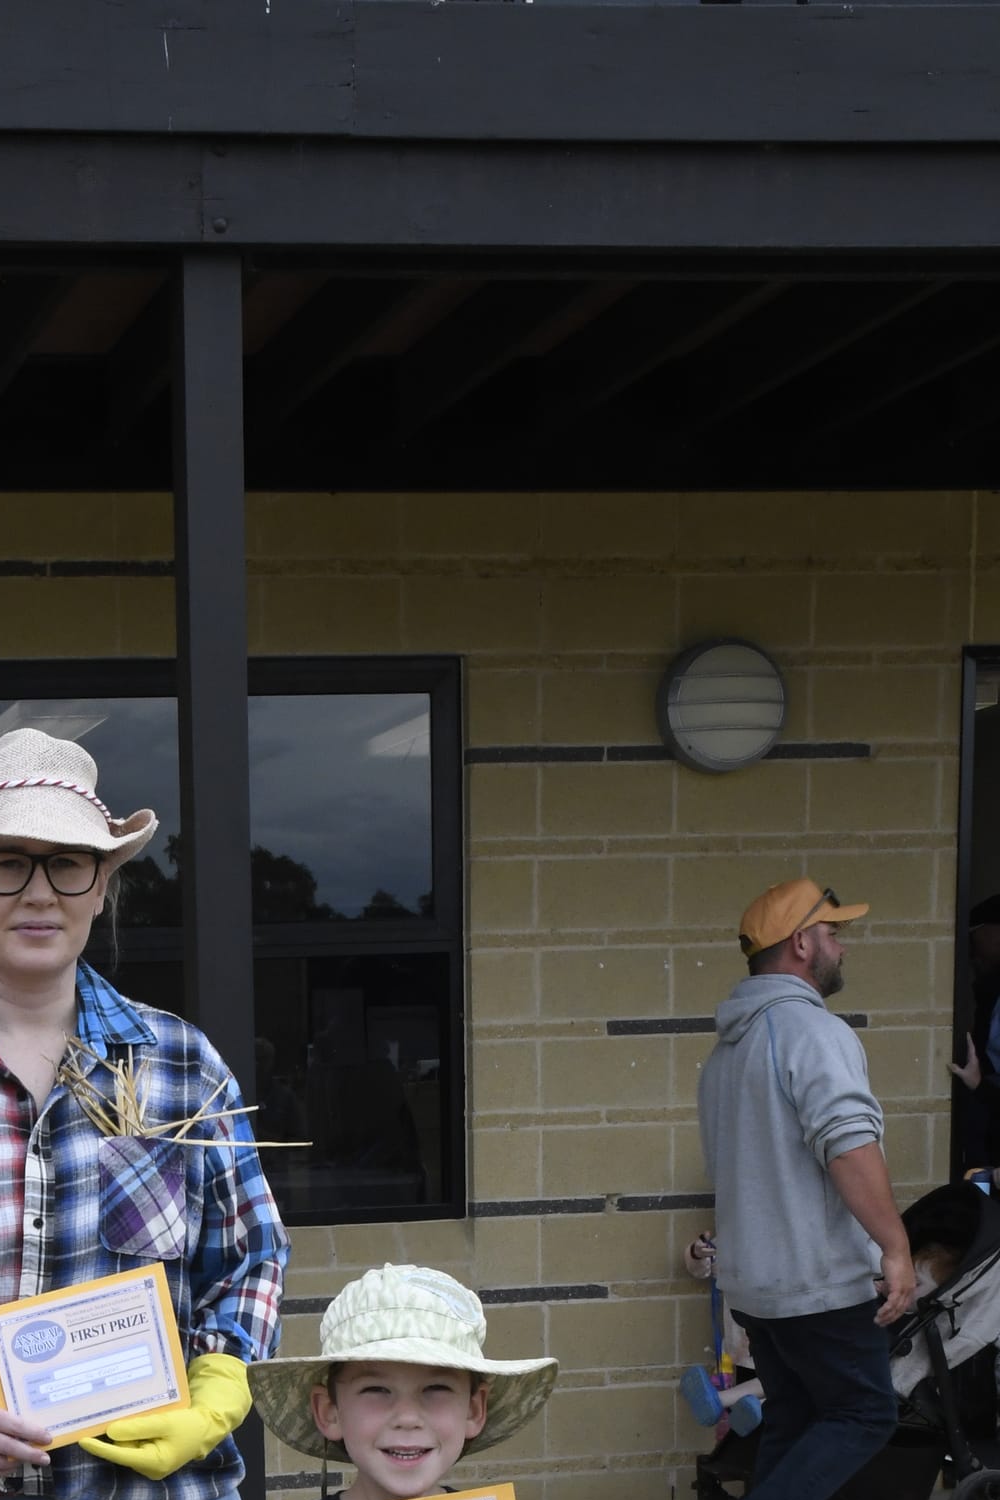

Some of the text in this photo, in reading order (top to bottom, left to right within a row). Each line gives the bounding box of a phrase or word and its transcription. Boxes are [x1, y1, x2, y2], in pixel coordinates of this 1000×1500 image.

[14, 1326, 63, 1350] ANNUAL
[70, 1323, 107, 1343] FIRST
[109, 1312, 149, 1333] PRIZE
[22, 1339, 57, 1358] SHOW
